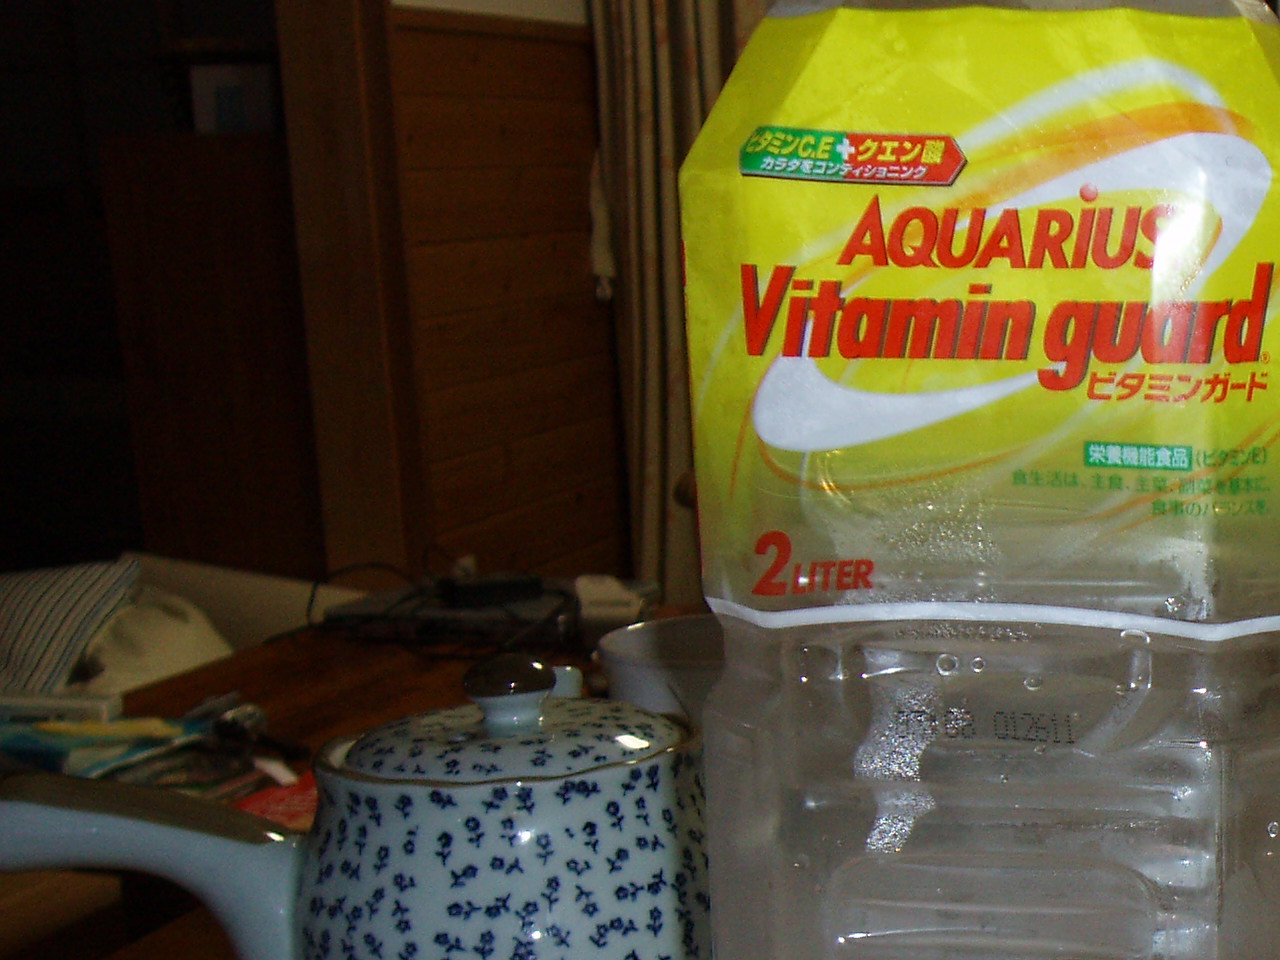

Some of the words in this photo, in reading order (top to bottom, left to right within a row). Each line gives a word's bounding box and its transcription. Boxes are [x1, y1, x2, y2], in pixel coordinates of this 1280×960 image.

[760, 156, 928, 179] カラダをコンディショニング
[740, 263, 1037, 361] Vitamin
[1038, 261, 1275, 391] guard
[1087, 372, 1269, 404] ビタミンガード
[1088, 443, 1189, 468] 栄養機能食品
[752, 530, 792, 596] 2
[792, 558, 875, 594] LITER
